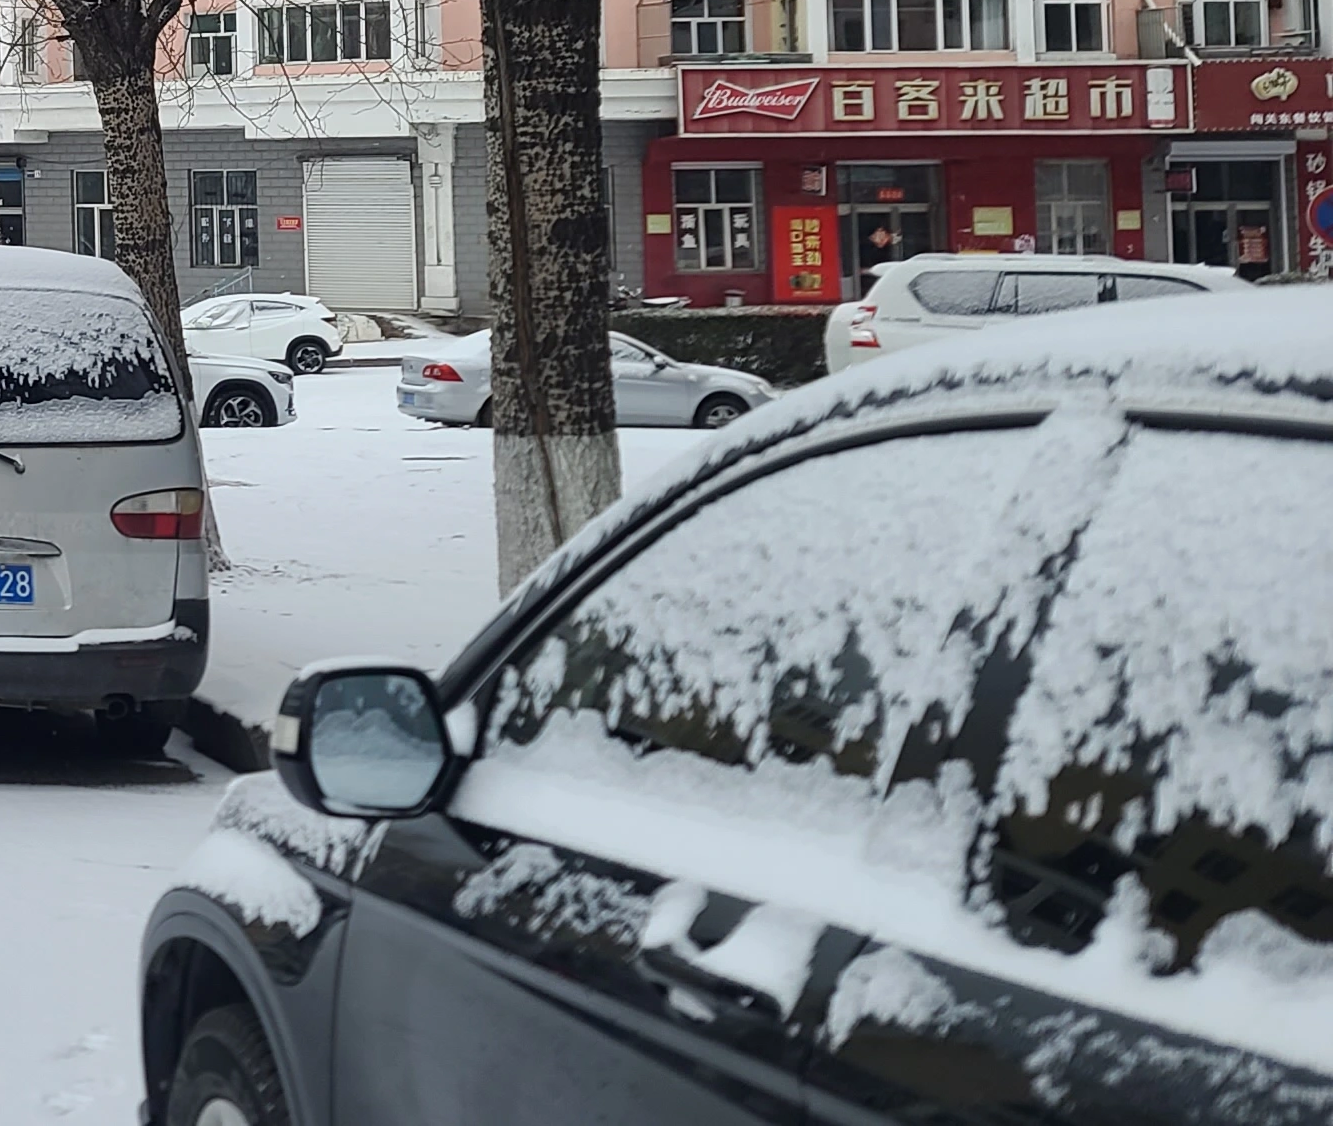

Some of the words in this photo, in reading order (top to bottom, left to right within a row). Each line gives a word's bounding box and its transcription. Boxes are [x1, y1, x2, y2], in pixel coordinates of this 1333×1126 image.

[704, 86, 805, 109] Budweiser
[831, 75, 1133, 122] 百客来超市
